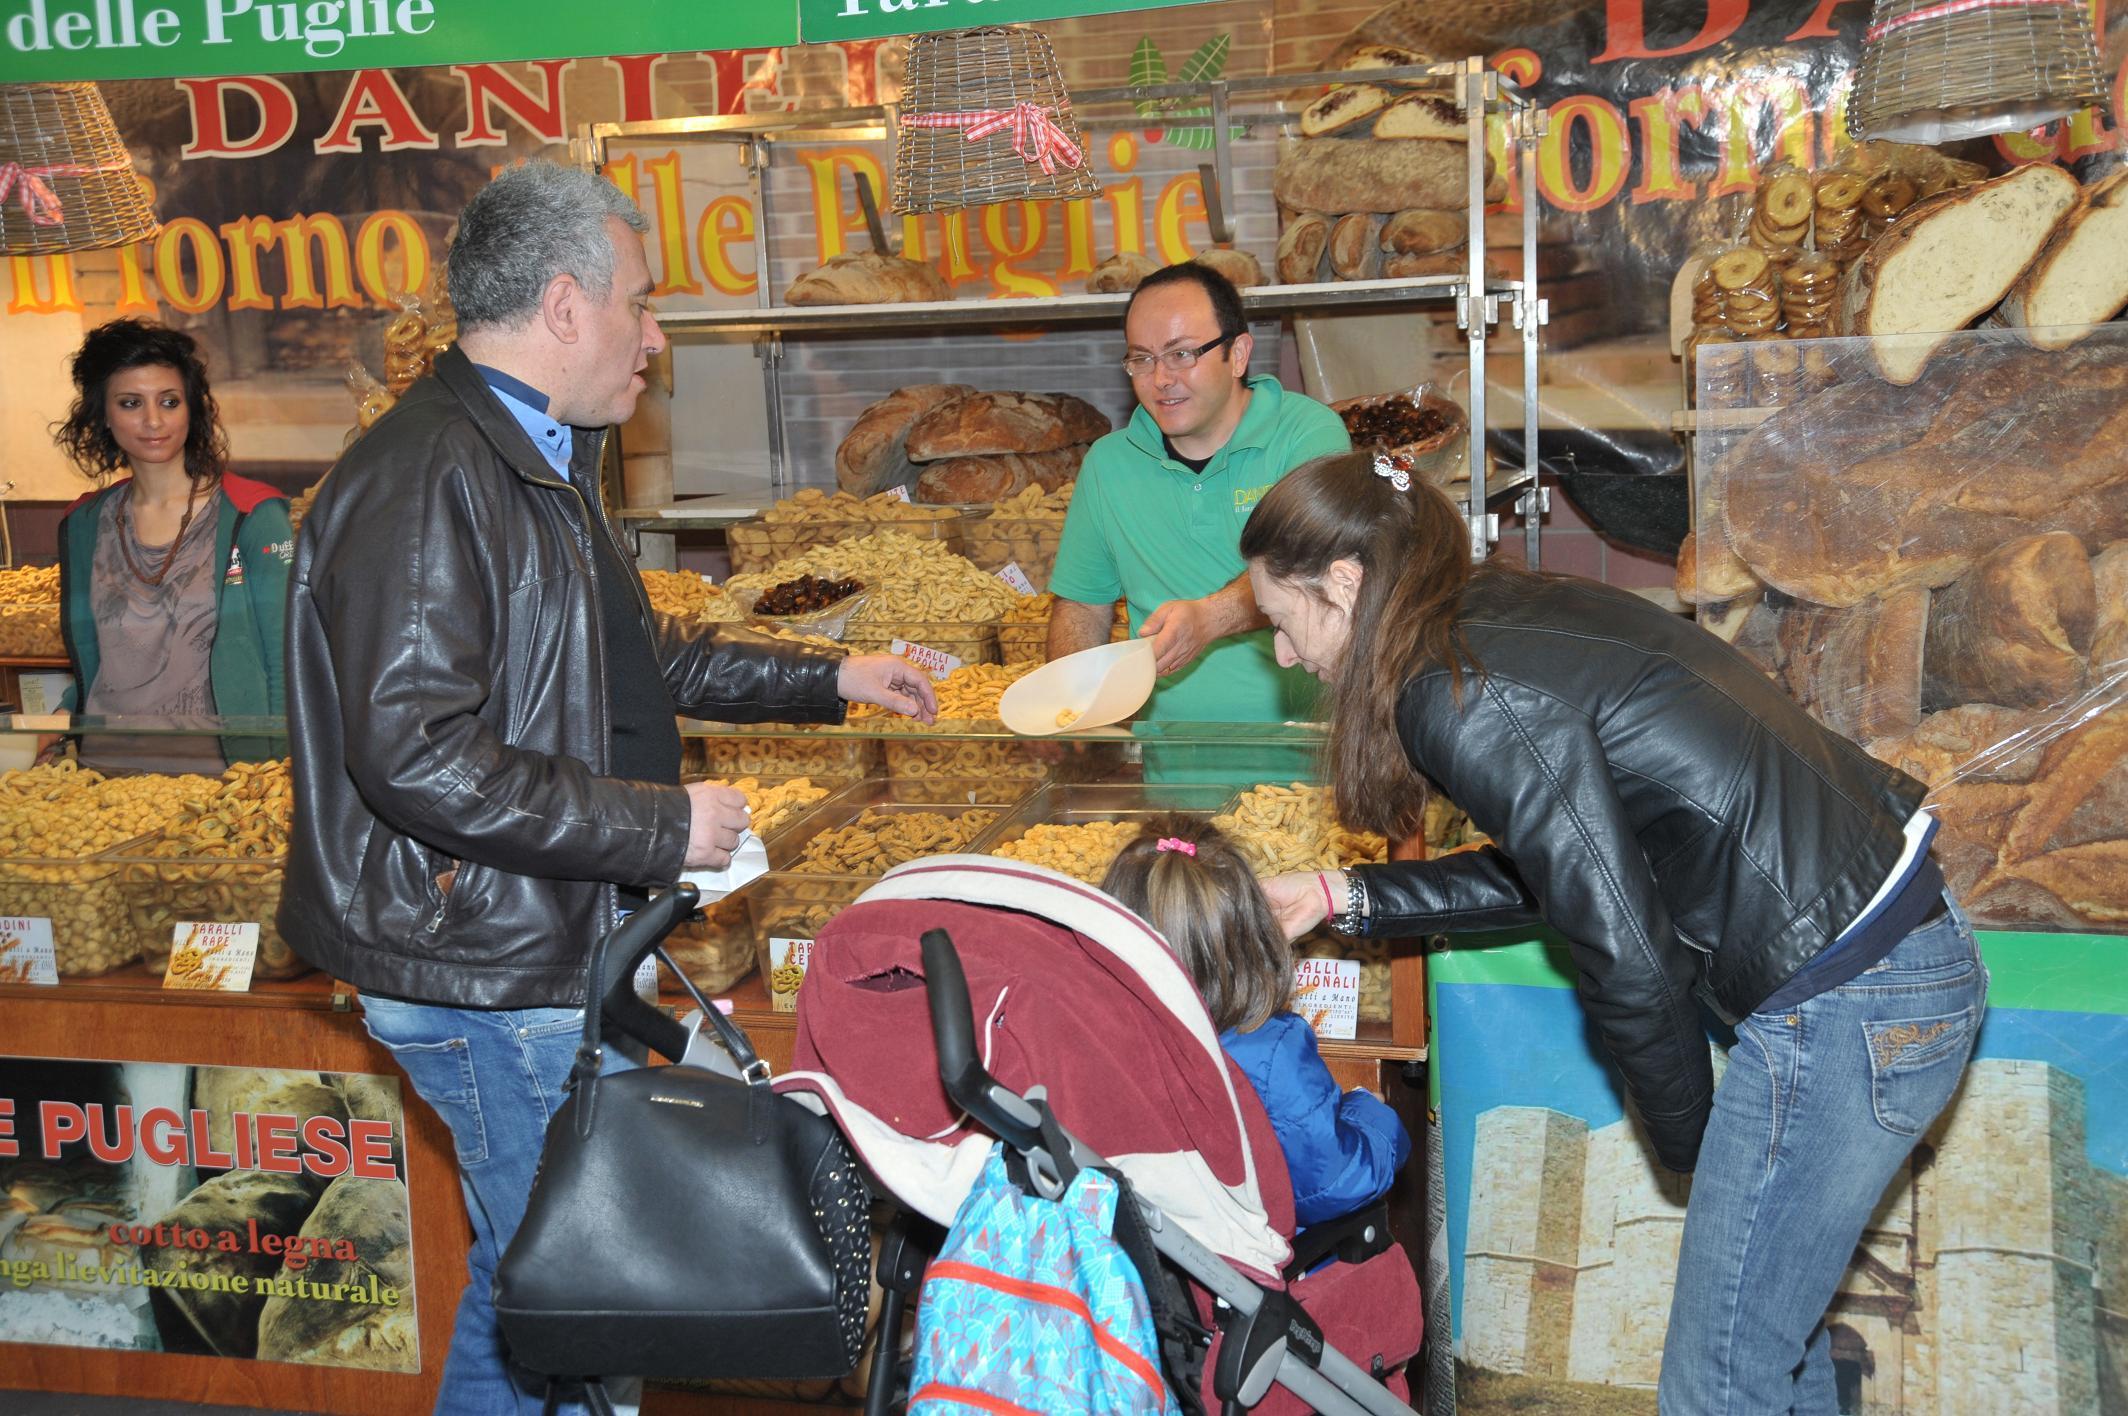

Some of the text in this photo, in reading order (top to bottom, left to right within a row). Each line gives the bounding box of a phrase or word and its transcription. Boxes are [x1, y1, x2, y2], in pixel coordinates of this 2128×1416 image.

[6, 0, 436, 58] delle Puglie
[1484, 47, 1858, 214] forn
[904, 643, 949, 665] TARALLI
[907, 655, 945, 673] IPOLLA
[0, 919, 31, 931] DINI
[192, 923, 244, 936] TARALLI
[202, 936, 231, 947] RAPE
[39, 1100, 397, 1182] PUGLIESE
[108, 1217, 360, 1271] cotto a legna
[55, 1249, 249, 1296] lievitazione
[256, 1272, 400, 1307] naturale
